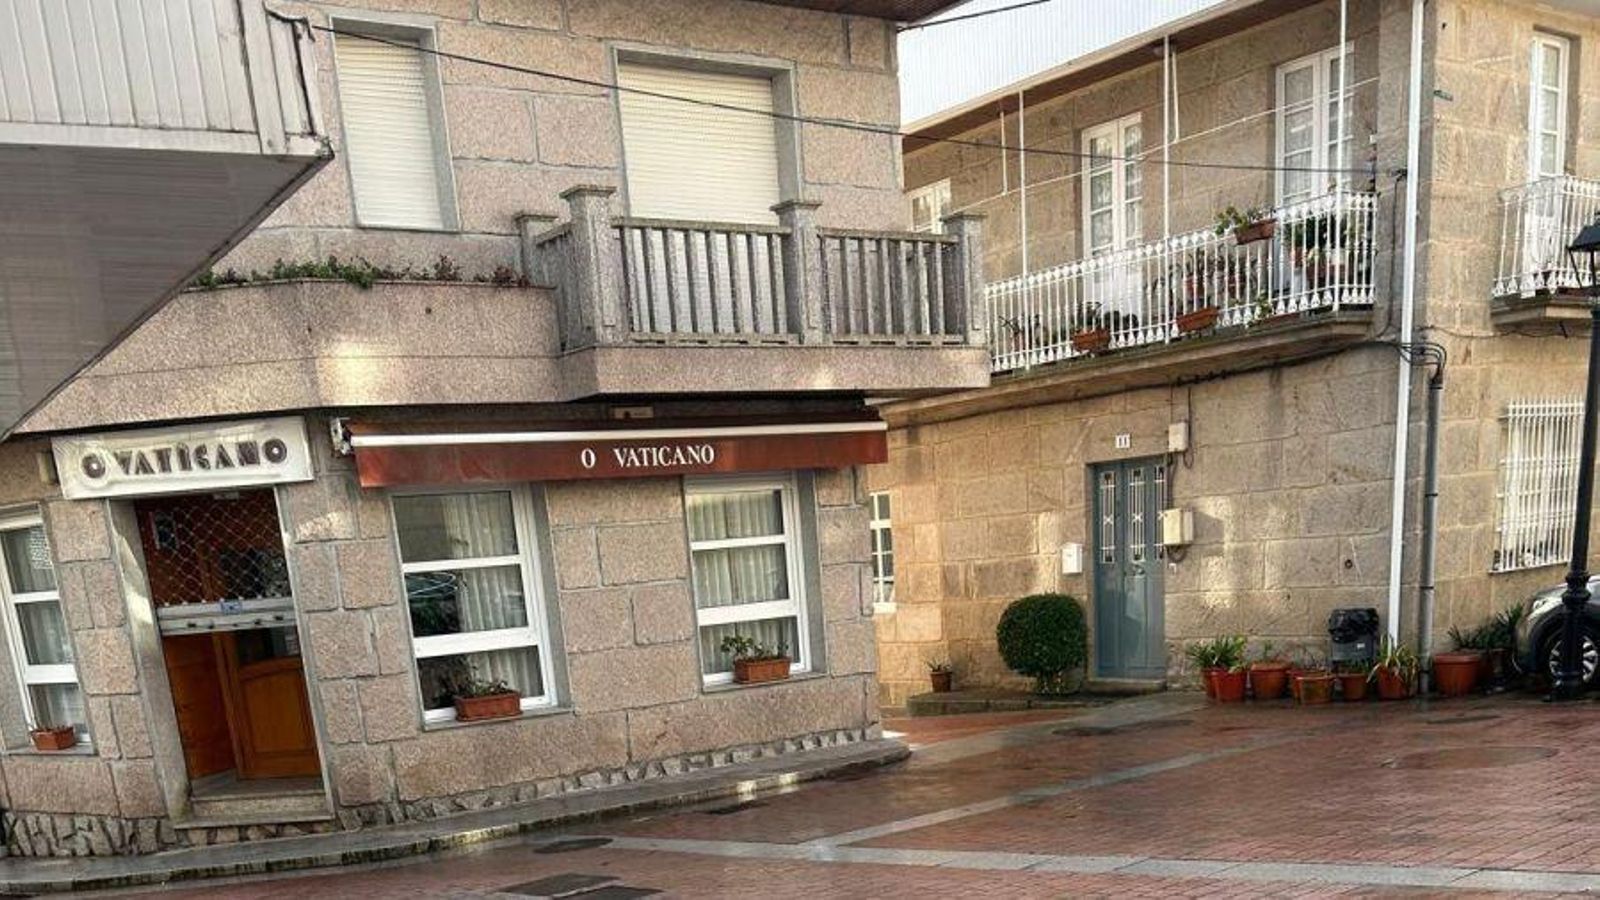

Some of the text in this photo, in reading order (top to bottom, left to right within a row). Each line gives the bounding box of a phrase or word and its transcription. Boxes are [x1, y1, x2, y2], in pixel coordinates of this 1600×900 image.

[81, 438, 288, 479] O VATICANO
[581, 444, 715, 469] O VATICANO
